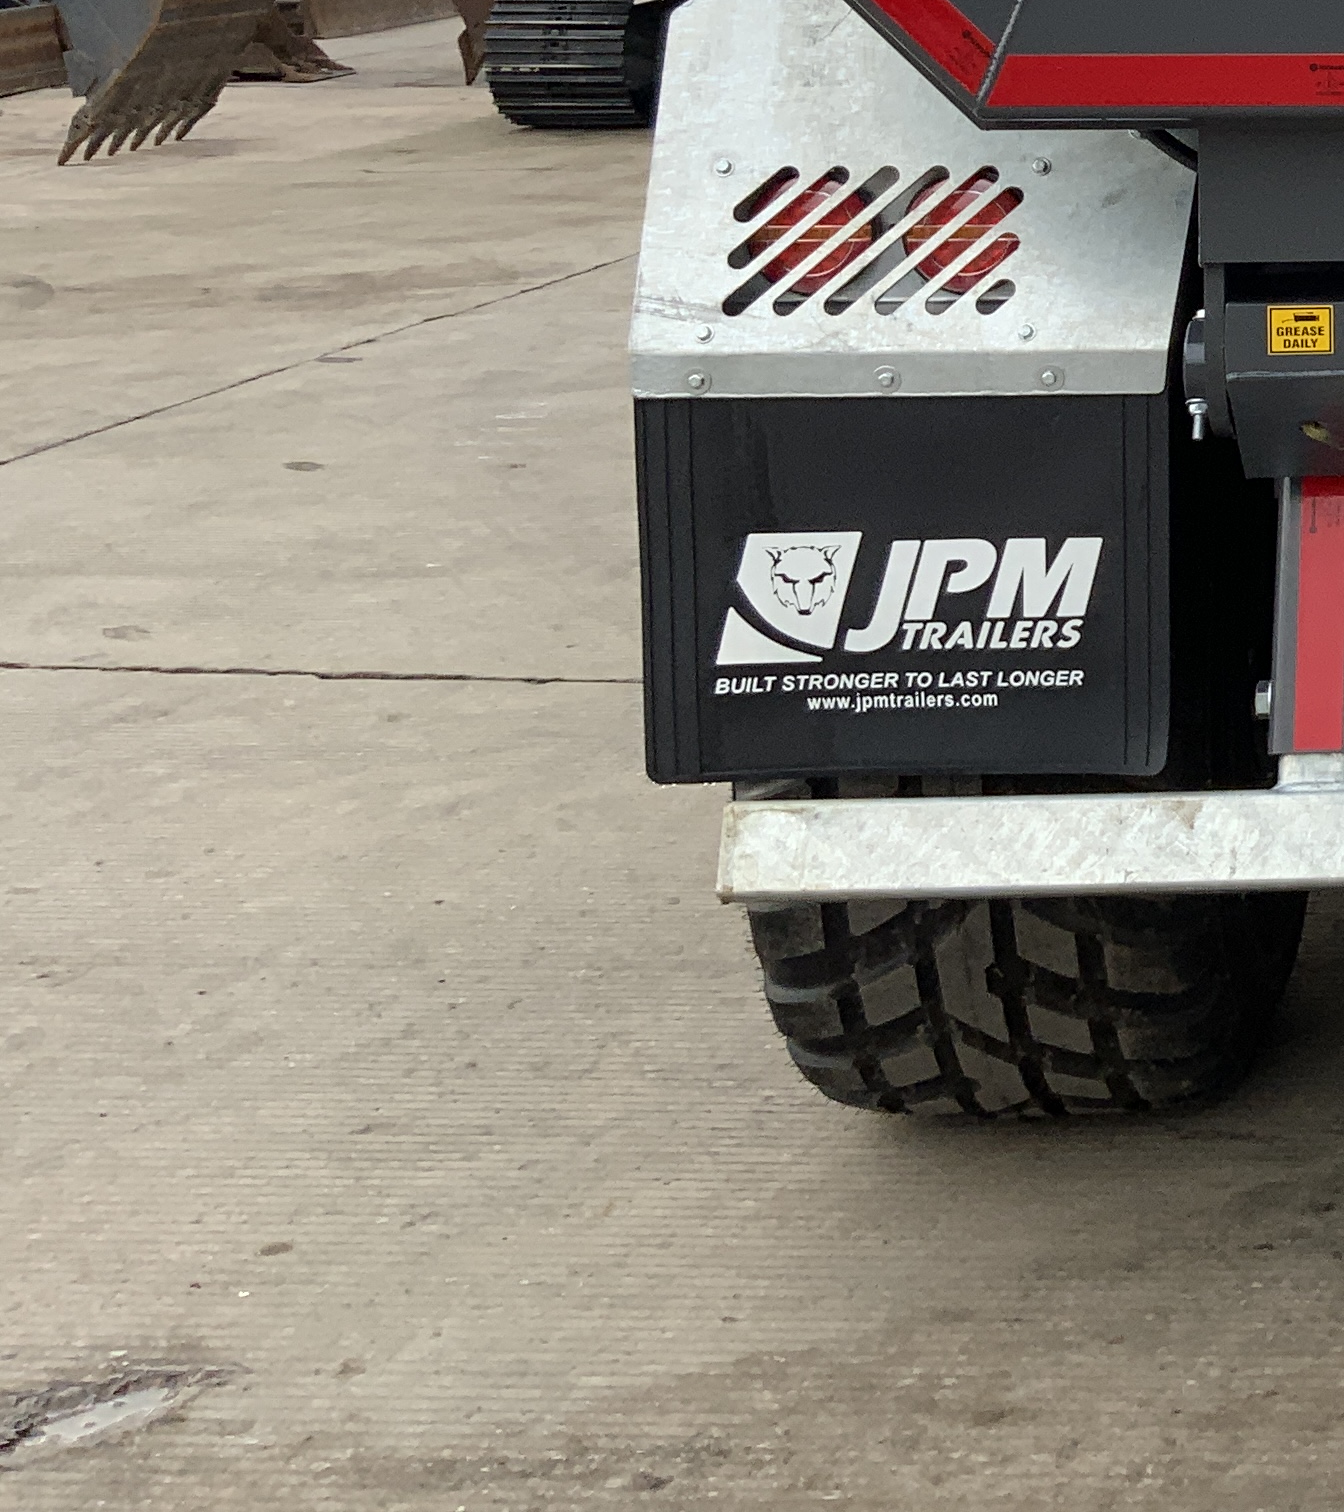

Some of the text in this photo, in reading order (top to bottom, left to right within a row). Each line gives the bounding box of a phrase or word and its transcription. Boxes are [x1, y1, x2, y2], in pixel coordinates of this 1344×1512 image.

[1276, 325, 1325, 337] GREASE
[1283, 338, 1319, 349] DAILY
[843, 537, 1103, 652] JPM
[900, 618, 1085, 651] TRAILERS
[714, 670, 1085, 695] BUILT STRONGER TO LAST LONGER
[807, 691, 999, 712] www.jpmtrailers.com
